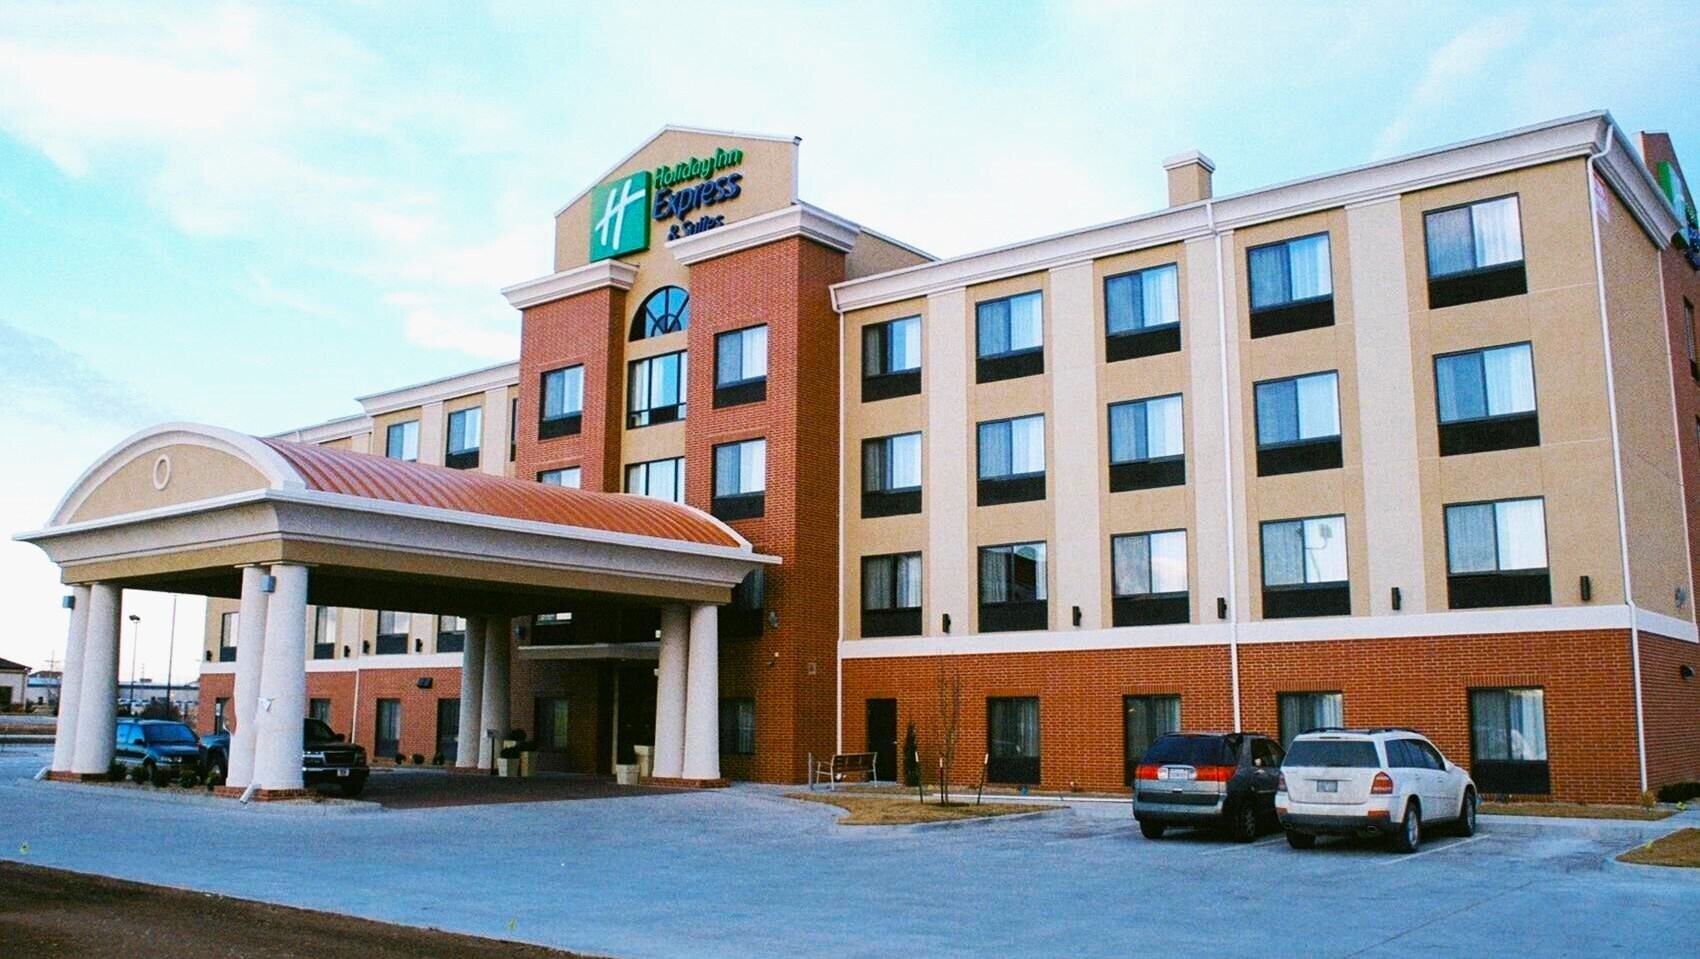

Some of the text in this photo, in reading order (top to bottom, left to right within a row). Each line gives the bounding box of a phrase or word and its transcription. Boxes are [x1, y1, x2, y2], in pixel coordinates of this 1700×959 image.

[654, 147, 744, 189] Holiday Inn
[653, 172, 743, 221] Express
